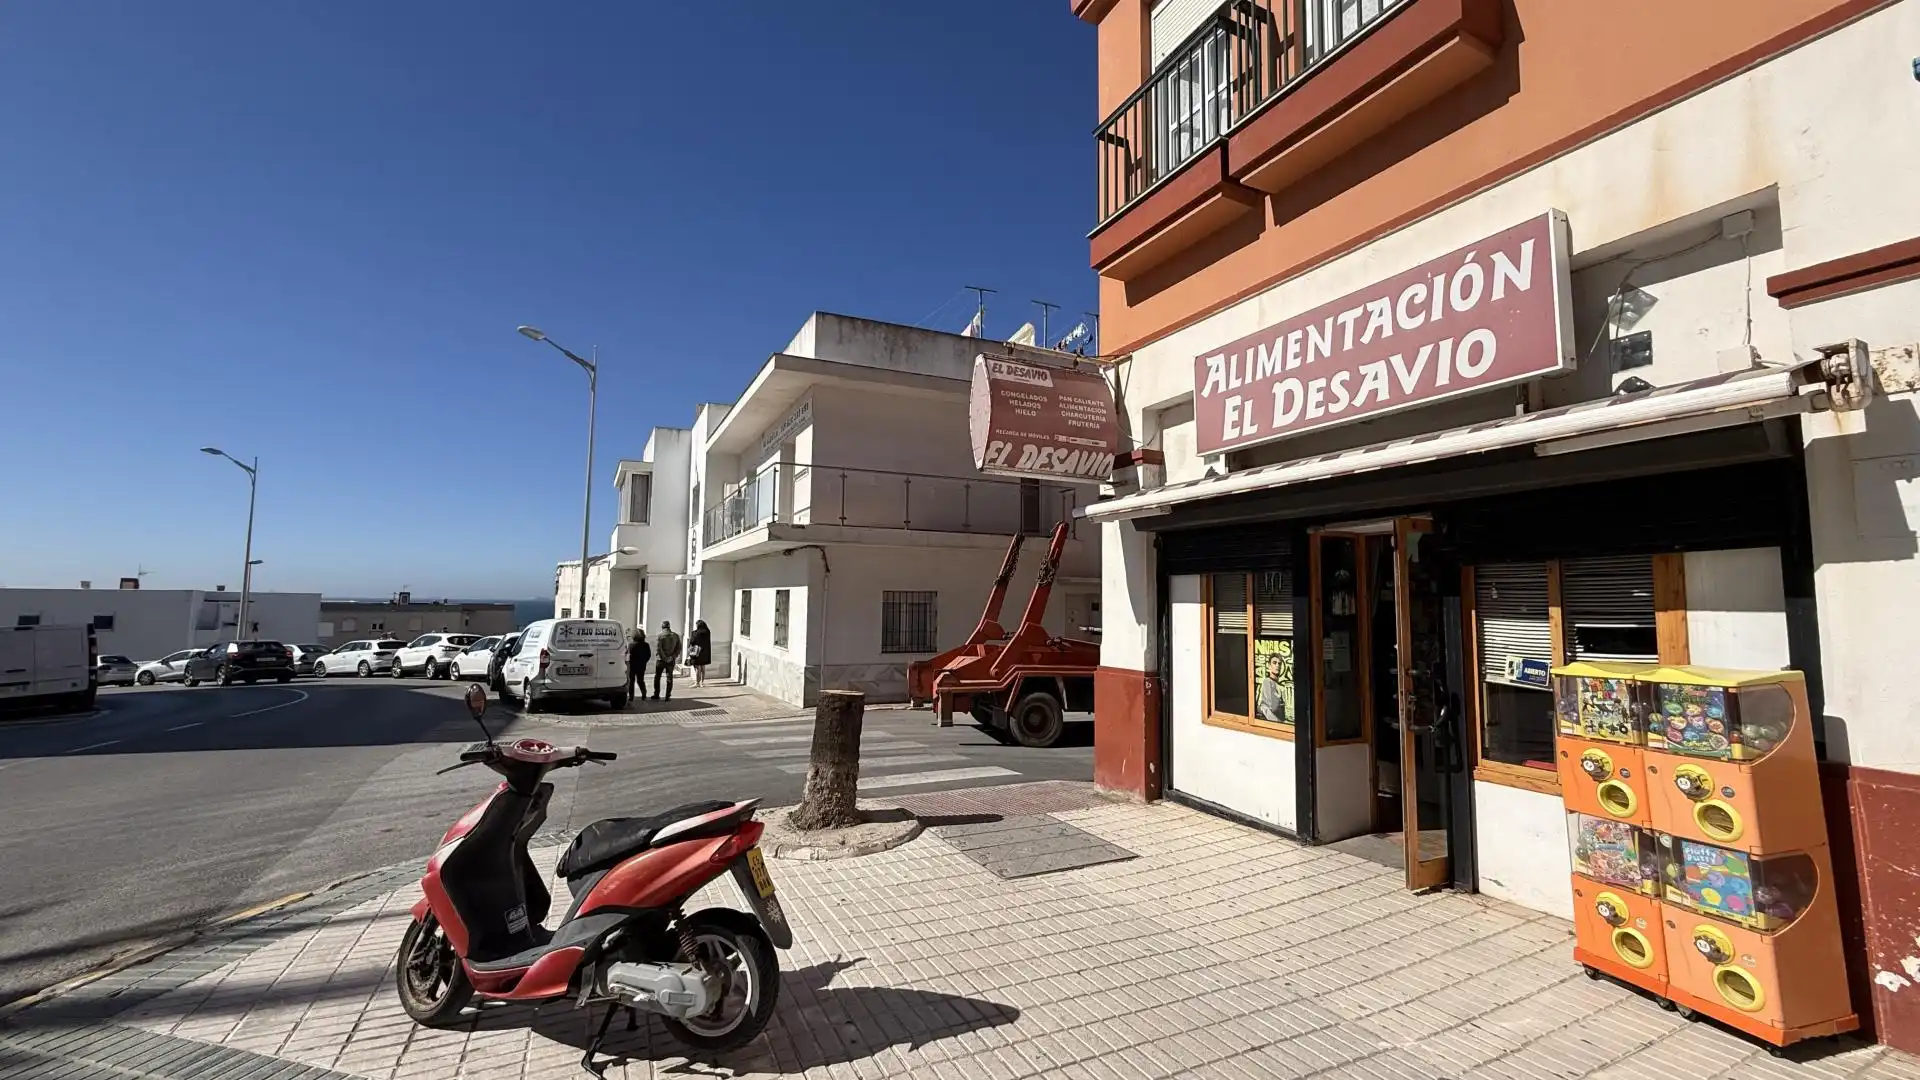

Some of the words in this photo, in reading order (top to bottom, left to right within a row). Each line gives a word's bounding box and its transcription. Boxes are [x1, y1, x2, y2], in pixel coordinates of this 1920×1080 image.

[1201, 238, 1536, 398] ALIMENTACIÓN
[992, 362, 1004, 374] EL
[1006, 364, 1048, 381] DESAVIO
[1222, 395, 1258, 442] EL
[1271, 328, 1497, 429] DESAVIO
[1000, 390, 1048, 403] CONGELADOS
[1058, 394, 1073, 403] PAN
[1074, 396, 1105, 407] CALIENTE
[1009, 399, 1042, 410] HELADOS
[1015, 408, 1037, 417] HIELO
[995, 429, 1020, 437] RECARGA
[984, 440, 1013, 467] EL
[1015, 444, 1116, 478] DESAVIO
[1524, 667, 1546, 677] ABIERTO
